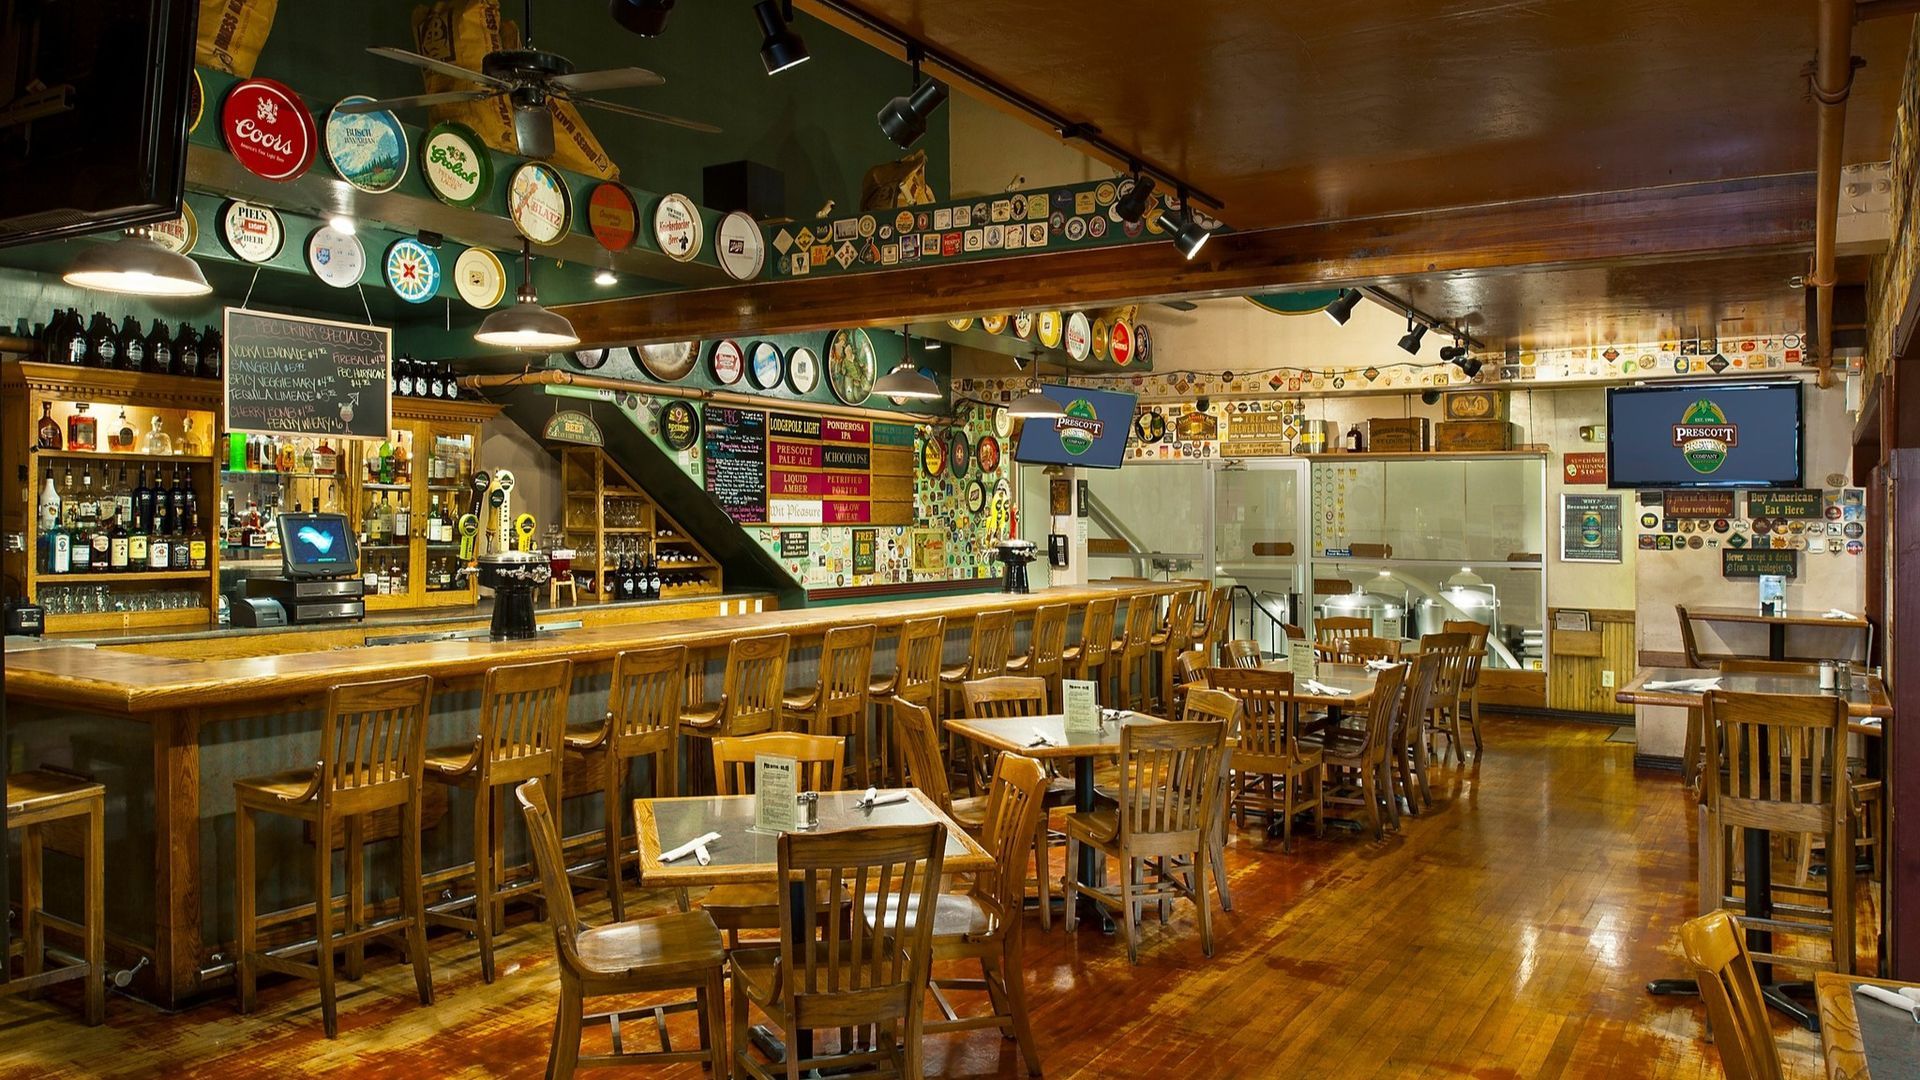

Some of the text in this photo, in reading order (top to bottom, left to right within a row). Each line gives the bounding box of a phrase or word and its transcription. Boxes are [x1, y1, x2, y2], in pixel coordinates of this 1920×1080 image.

[235, 118, 293, 155] Coors
[345, 127, 372, 138] BUSCH
[430, 144, 478, 185] Grolsch
[530, 201, 562, 225] BLATZ
[248, 222, 266, 231] LIGHT
[243, 234, 264, 245] BEER
[254, 319, 373, 346] PBC DRINK SPECIALS
[229, 344, 261, 359] VODKA
[262, 346, 307, 361] LEMONADE
[332, 352, 372, 366] FIREBALL
[231, 360, 284, 375] SANGRIA
[337, 367, 353, 379] PBC
[229, 373, 256, 390] SPICY
[293, 377, 316, 393] MARY
[229, 388, 273, 401] TEQUILA
[274, 391, 315, 402] LIMEADE
[230, 405, 266, 422] CHERRY
[268, 406, 297, 419] BOMB
[675, 408, 683, 421] 9
[770, 417, 803, 433] LODGEPOLE
[803, 422, 820, 435] LIGHT
[827, 420, 865, 432] PONDEROSA
[1057, 416, 1101, 434] PRESCOTT
[841, 432, 852, 440] IPA
[1675, 427, 1734, 442] PRESCOTT
[776, 444, 814, 456] PRESCOTT
[1684, 439, 1727, 454] BREWING
[778, 455, 812, 466] PALE ALE
[825, 451, 868, 465] ACHOCOLYPSE
[783, 473, 808, 483] LIQUID
[827, 475, 863, 484] PETRIFIED
[783, 484, 808, 493] AMBER
[832, 486, 858, 495] PORTER
[1751, 493, 1768, 505] Buy
[770, 505, 784, 517] Wit
[787, 503, 821, 520] Pleasure
[833, 503, 860, 511] WILLOW
[1765, 505, 1804, 515] Eat Here
[835, 512, 858, 521] WHEAT
[856, 531, 875, 541] FREE
[1726, 552, 1743, 562] Never
